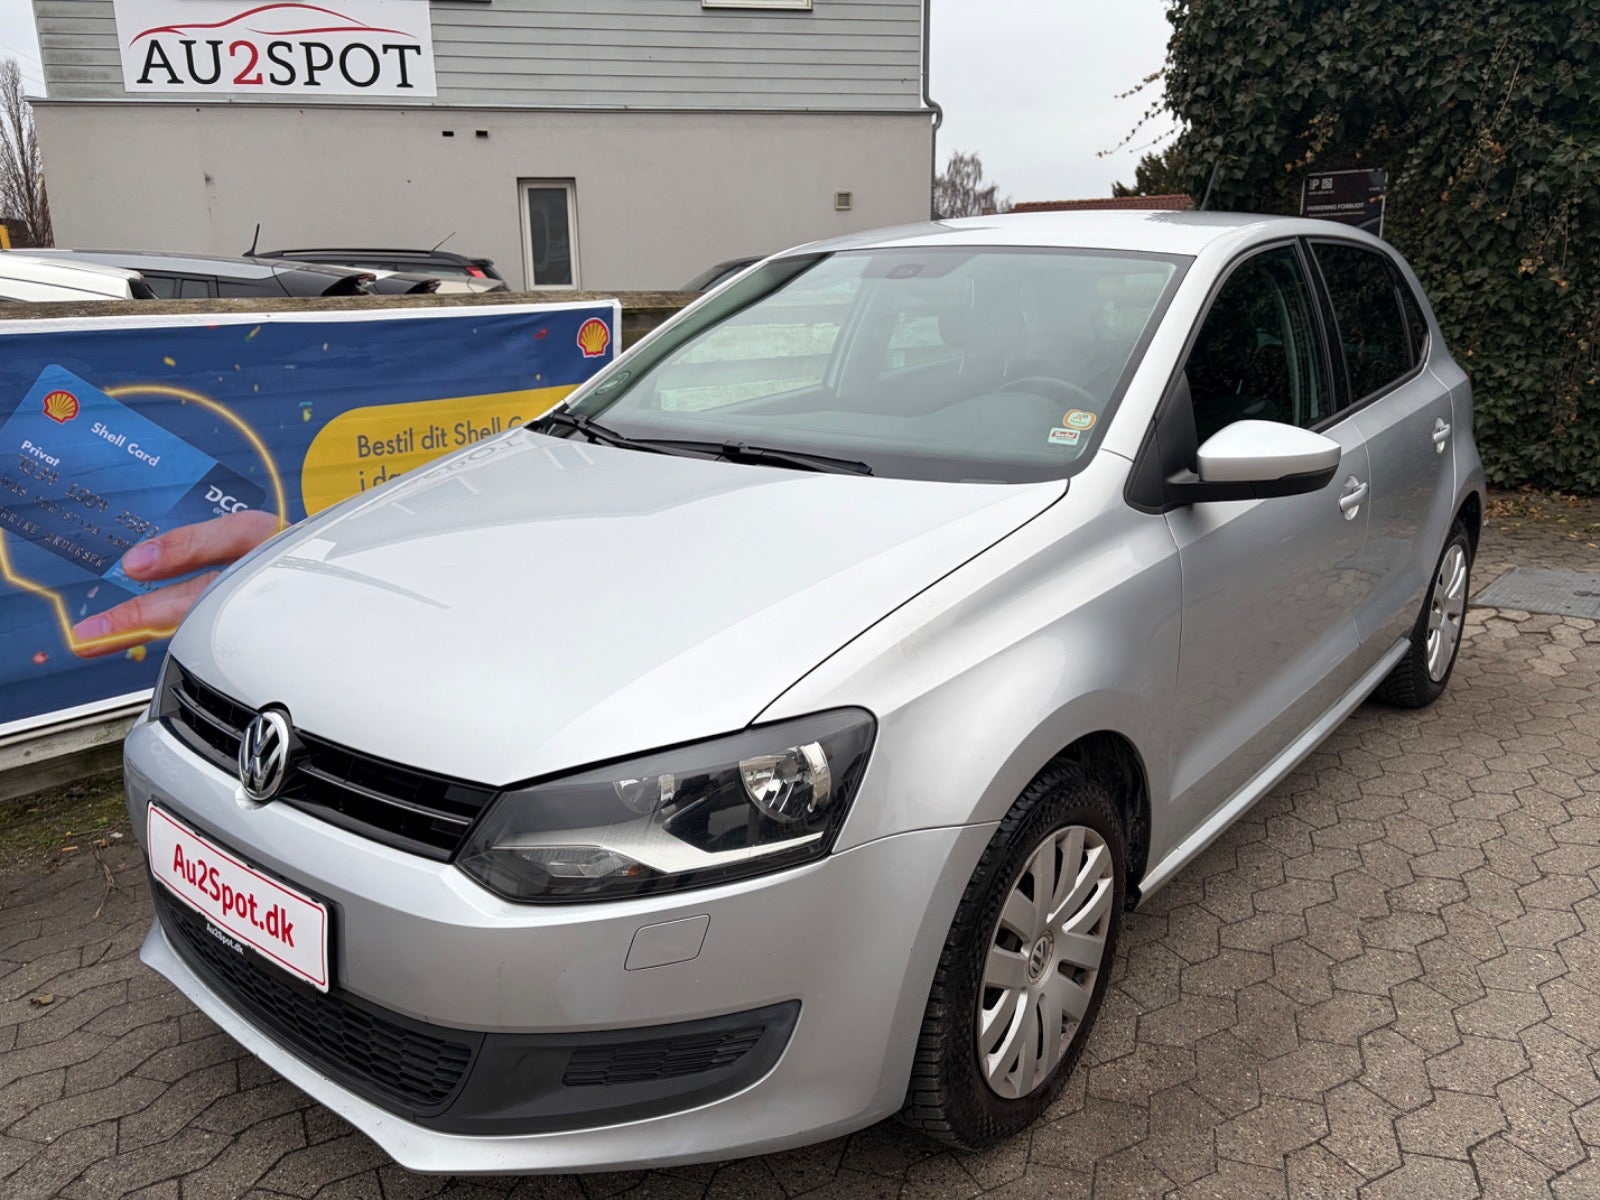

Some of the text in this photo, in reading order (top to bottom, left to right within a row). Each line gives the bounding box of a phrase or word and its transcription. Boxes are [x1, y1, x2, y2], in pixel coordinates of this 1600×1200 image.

[136, 39, 422, 88] AU2SPOT
[21, 440, 61, 467] Privat
[90, 422, 161, 467] Shell Card
[357, 427, 414, 458] Bestil
[421, 424, 448, 450] dit
[454, 417, 501, 445] Shell
[204, 485, 249, 513] DCC
[359, 470, 365, 491] i
[173, 844, 295, 948] Au2Spot.dk
